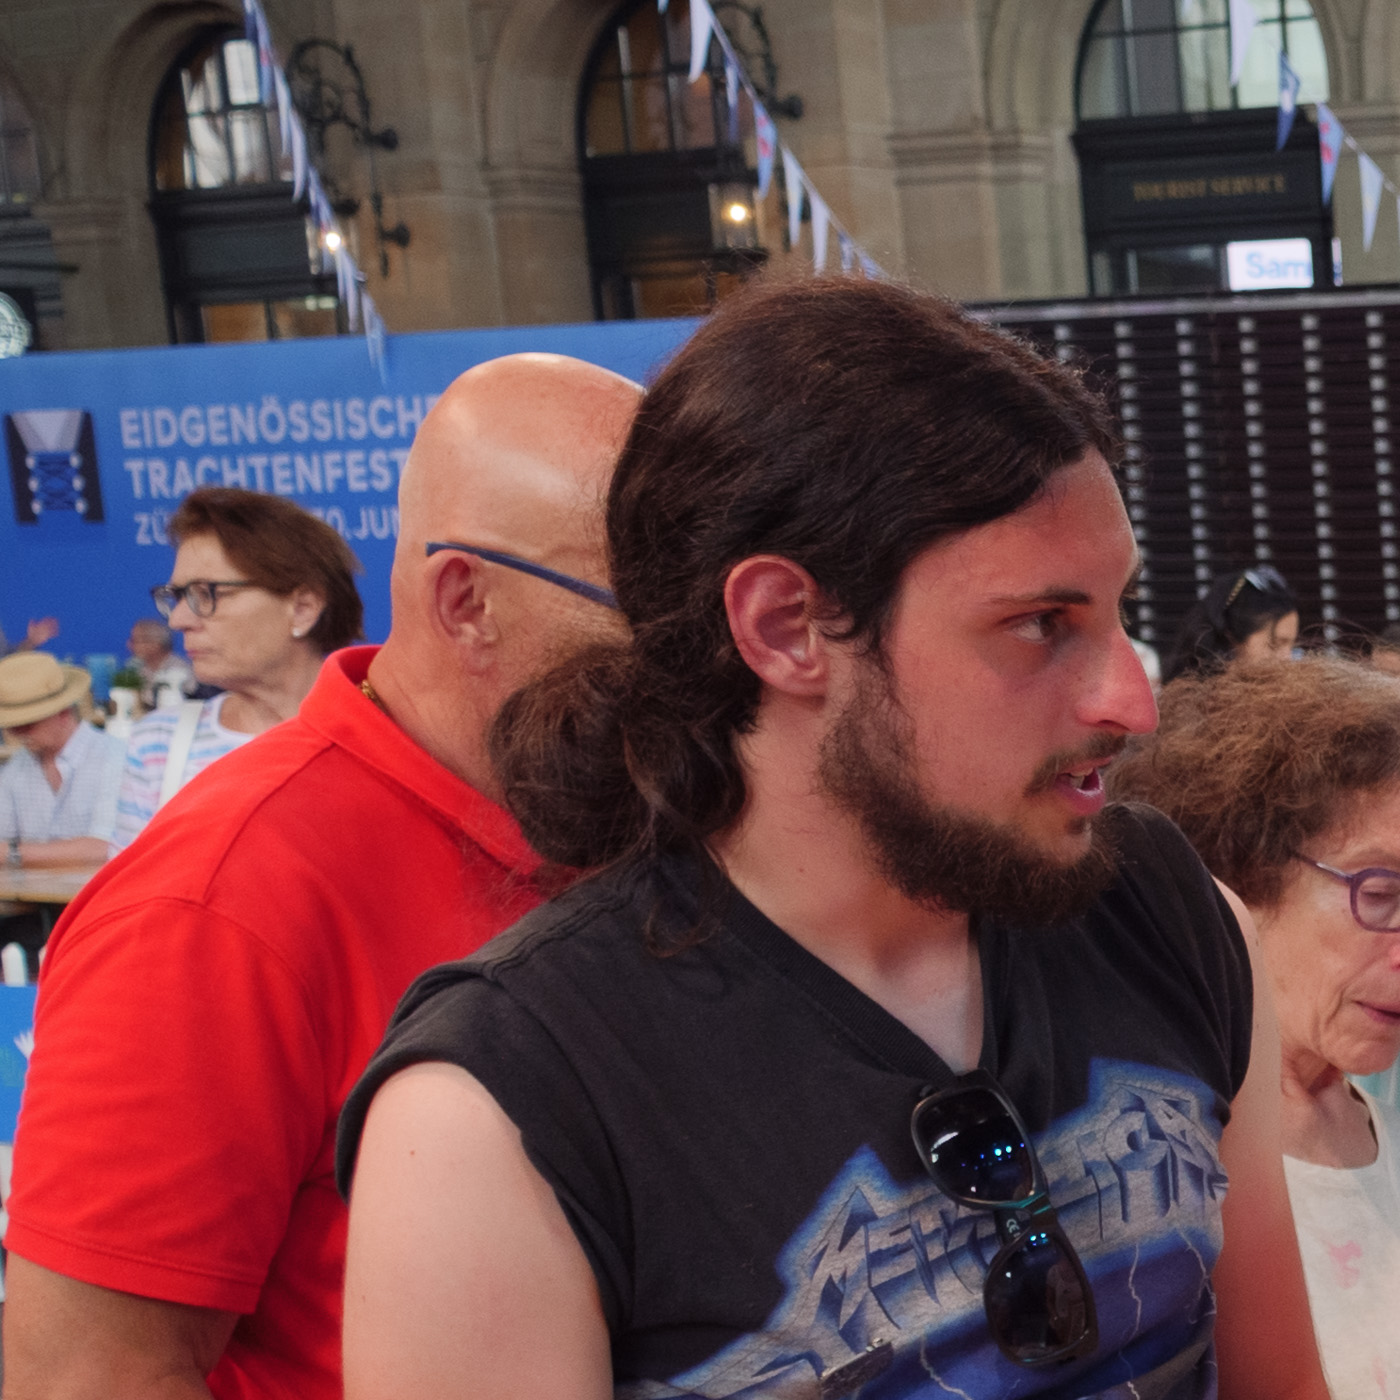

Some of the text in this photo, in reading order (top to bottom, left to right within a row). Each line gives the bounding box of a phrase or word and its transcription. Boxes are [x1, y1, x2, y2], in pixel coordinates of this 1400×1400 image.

[1133, 173, 1285, 201] TOURIST SERVICE
[123, 448, 411, 499] TRACHTENFEST
